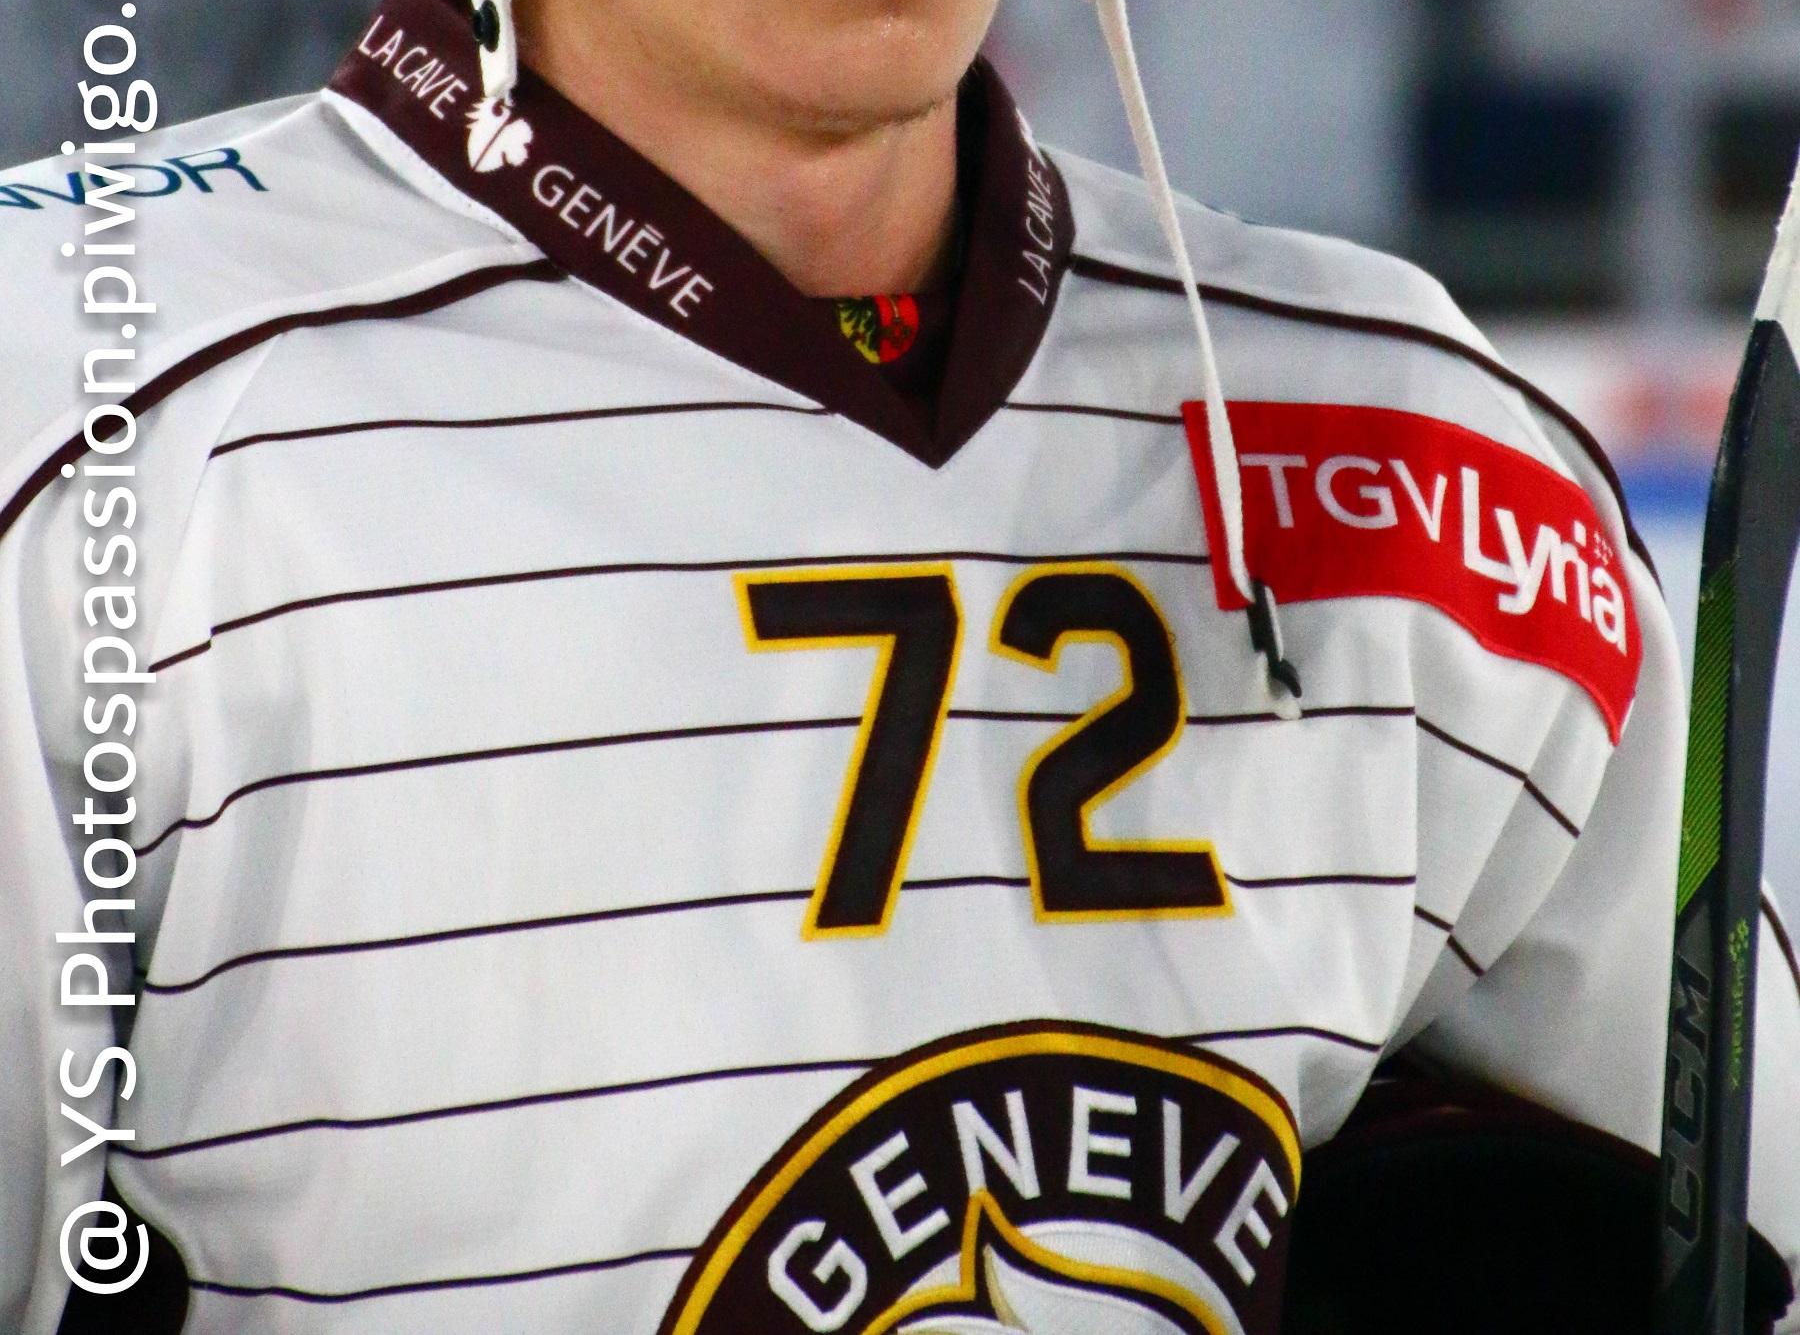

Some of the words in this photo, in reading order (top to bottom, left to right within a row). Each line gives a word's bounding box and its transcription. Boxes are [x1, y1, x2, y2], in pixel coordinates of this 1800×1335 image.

[358, 14, 404, 67] LA
[393, 46, 470, 120] CAVE
[1025, 159, 1053, 252] CAVE
[1018, 250, 1052, 307] LA
[732, 560, 1235, 943] 72
[767, 1085, 1290, 1334] GENEVE
